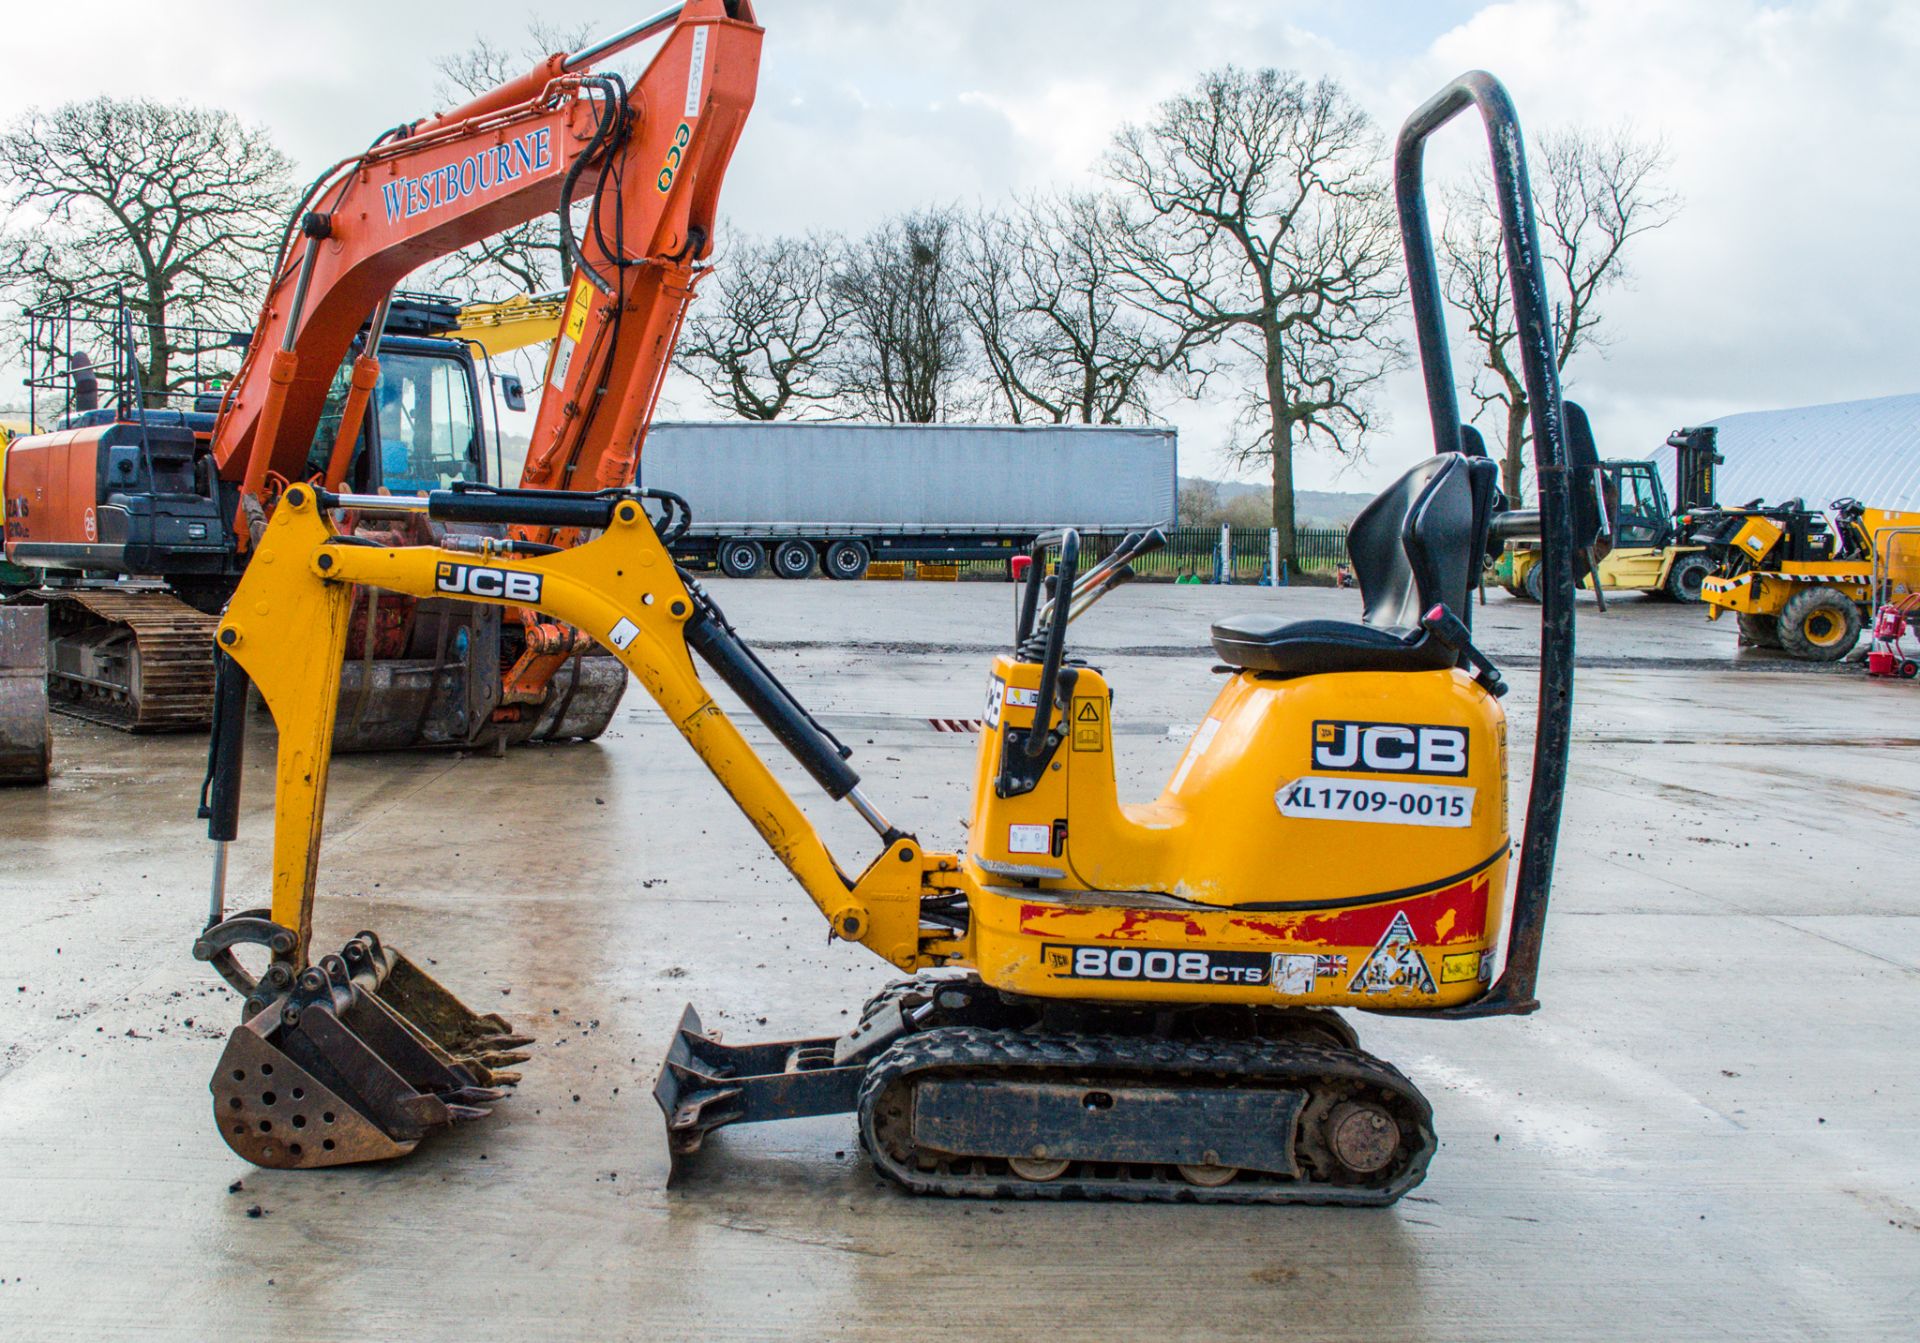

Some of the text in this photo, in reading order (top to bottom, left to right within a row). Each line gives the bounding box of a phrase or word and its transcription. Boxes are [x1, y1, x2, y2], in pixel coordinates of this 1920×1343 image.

[688, 31, 706, 112] HITACHI
[382, 126, 552, 225] WESTBOURNE
[656, 122, 691, 194] eco
[438, 566, 540, 602] JCB
[1316, 724, 1467, 773] JCB
[1283, 786, 1465, 818] XL1709-0015
